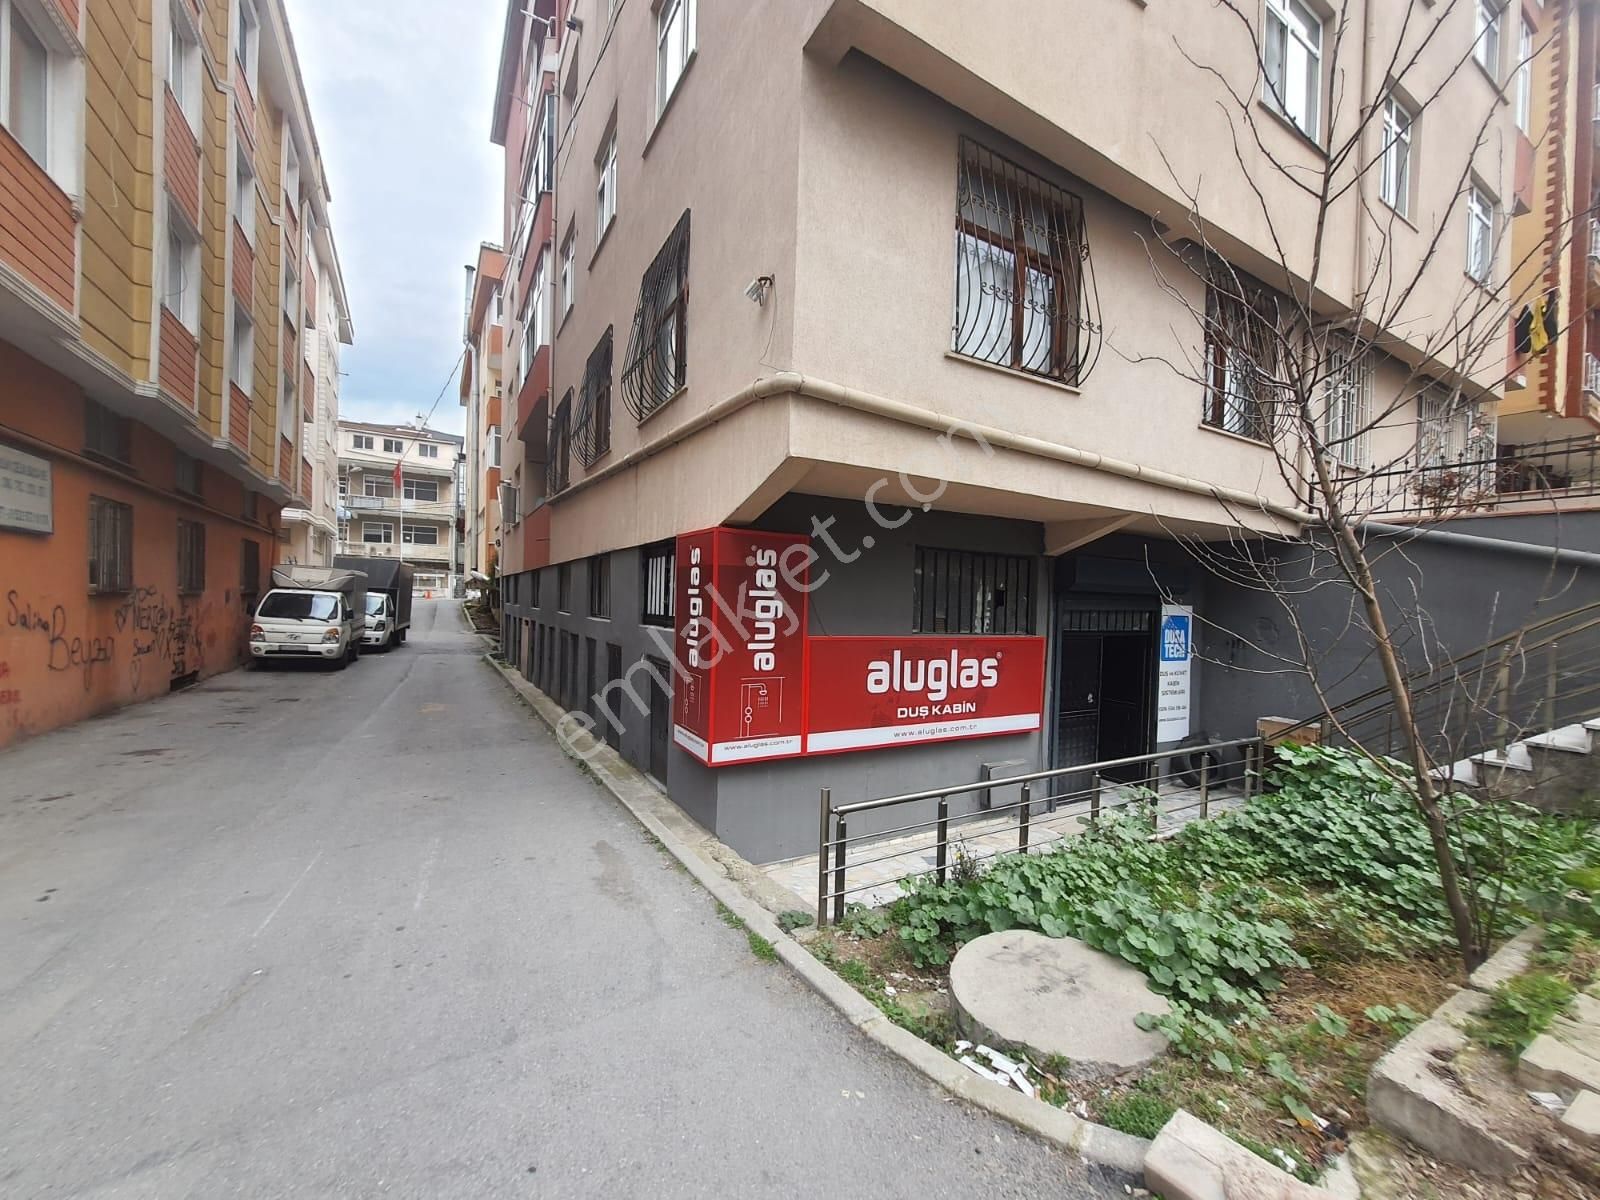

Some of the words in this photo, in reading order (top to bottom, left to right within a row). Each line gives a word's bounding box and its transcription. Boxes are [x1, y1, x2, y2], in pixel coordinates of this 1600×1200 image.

[686, 546, 703, 668] aluglas
[747, 548, 784, 672] aluglas
[866, 649, 999, 701] aluglas
[893, 723, 978, 738] www.aluglas.com.tr
[896, 705, 930, 719] DUŞ
[931, 701, 977, 716] KABİN
